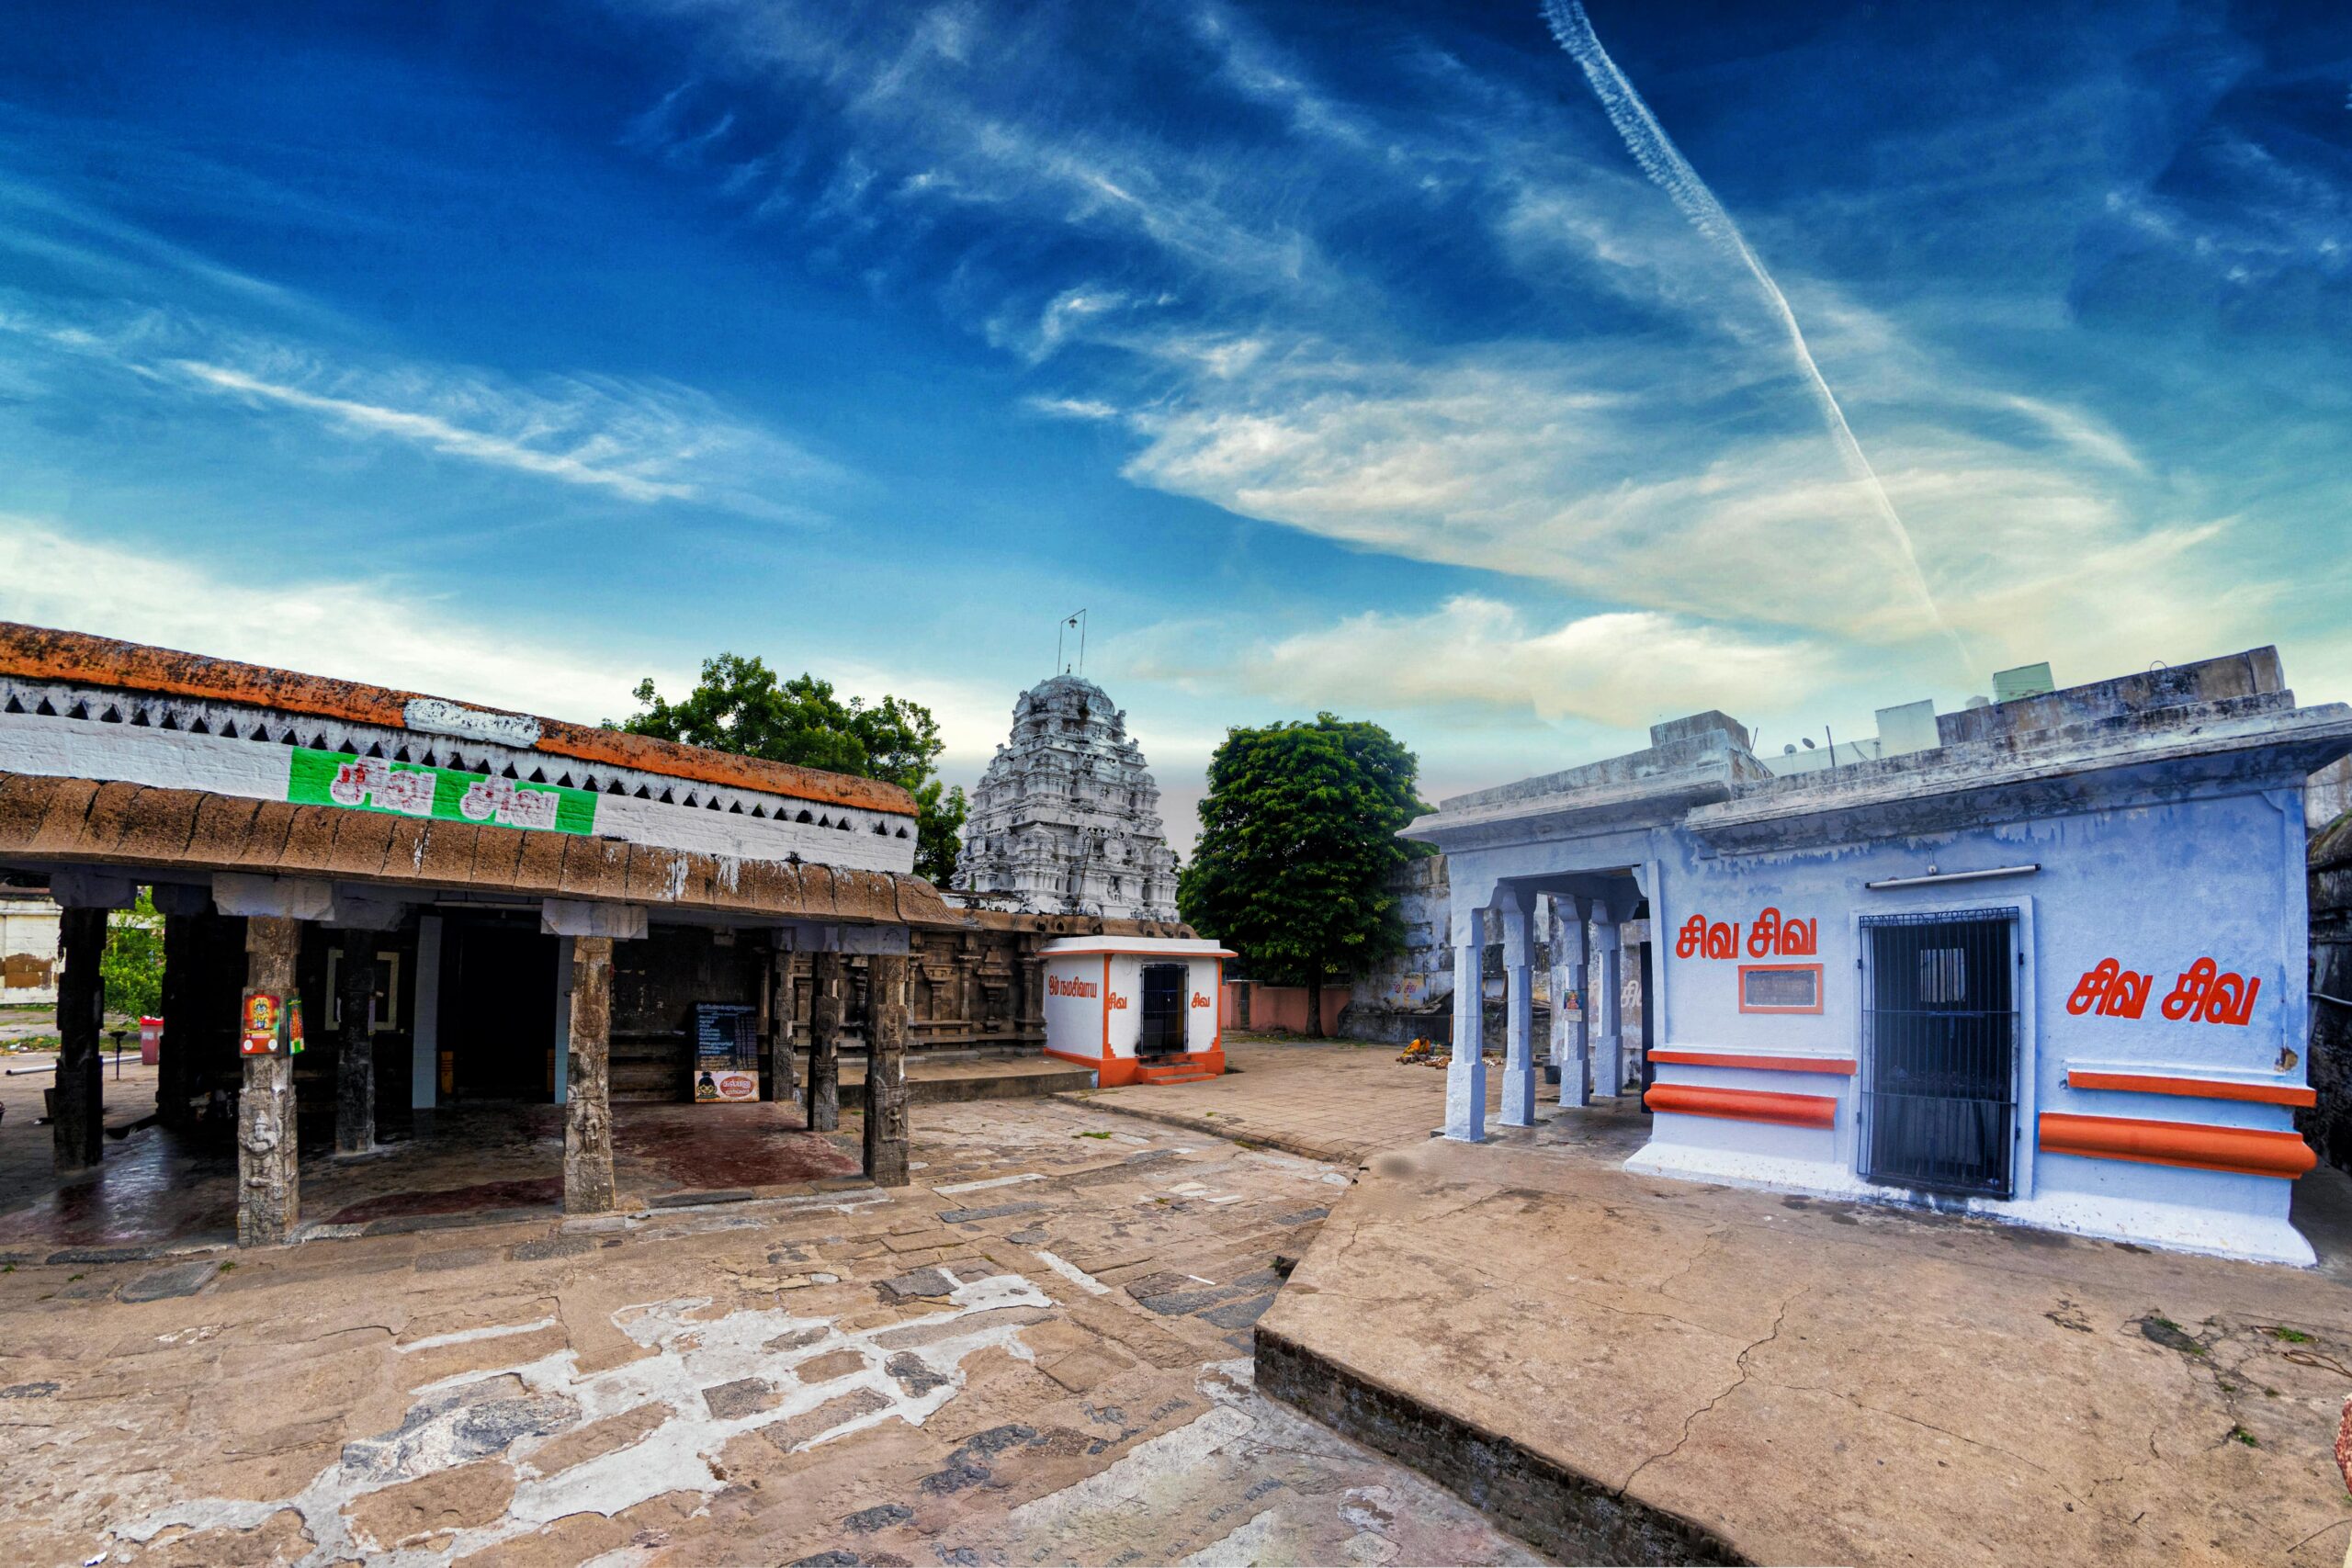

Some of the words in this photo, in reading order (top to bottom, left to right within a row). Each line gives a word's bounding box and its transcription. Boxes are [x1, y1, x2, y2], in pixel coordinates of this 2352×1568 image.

[1676, 914, 1739, 959] சிவ
[1747, 907, 1816, 958] சிவ
[1060, 976, 1097, 998] நமசிவாய
[2066, 957, 2154, 1019] சிவ
[2161, 956, 2261, 1026] சிவ
[1108, 992, 1127, 1010] சிவ
[1192, 992, 1210, 1008] சிவ
